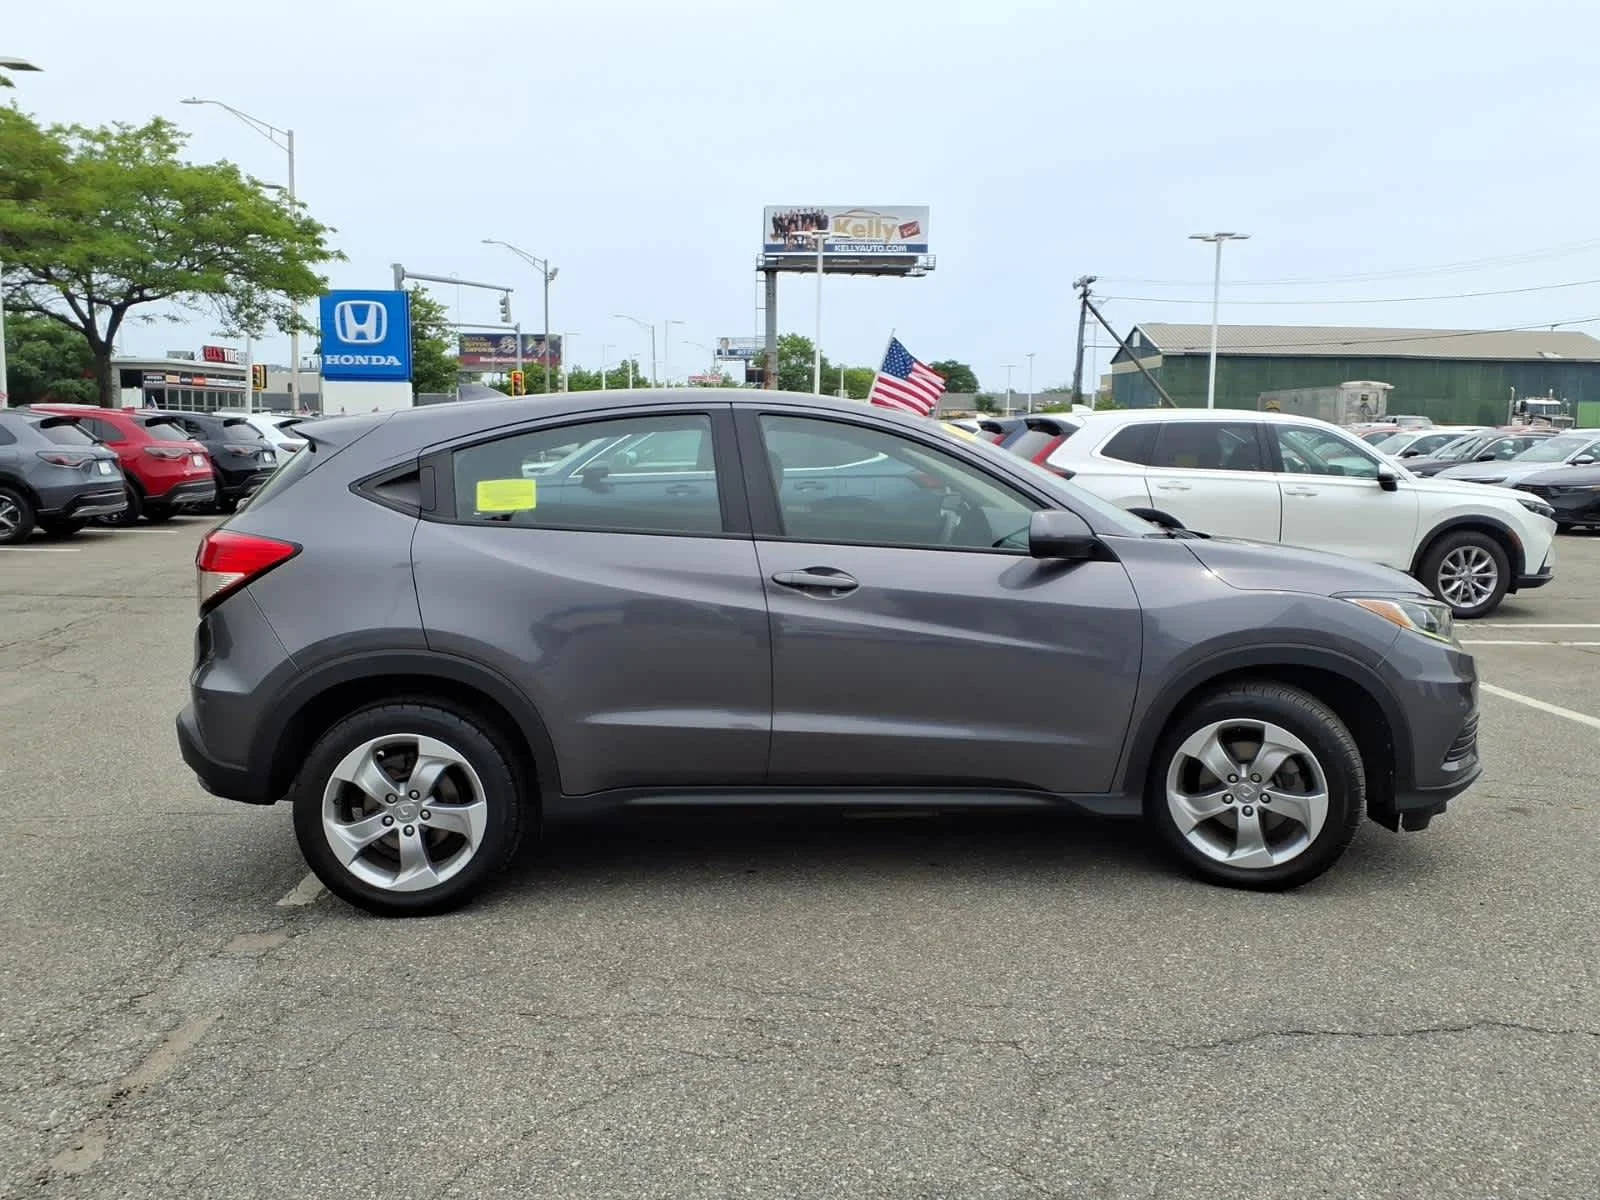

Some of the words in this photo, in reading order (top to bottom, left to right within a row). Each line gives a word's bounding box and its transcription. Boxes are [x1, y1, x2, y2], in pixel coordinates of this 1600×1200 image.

[834, 216, 898, 244] Kelly
[834, 244, 907, 253] KELLYAUTO.COM
[324, 354, 402, 366] HONDA
